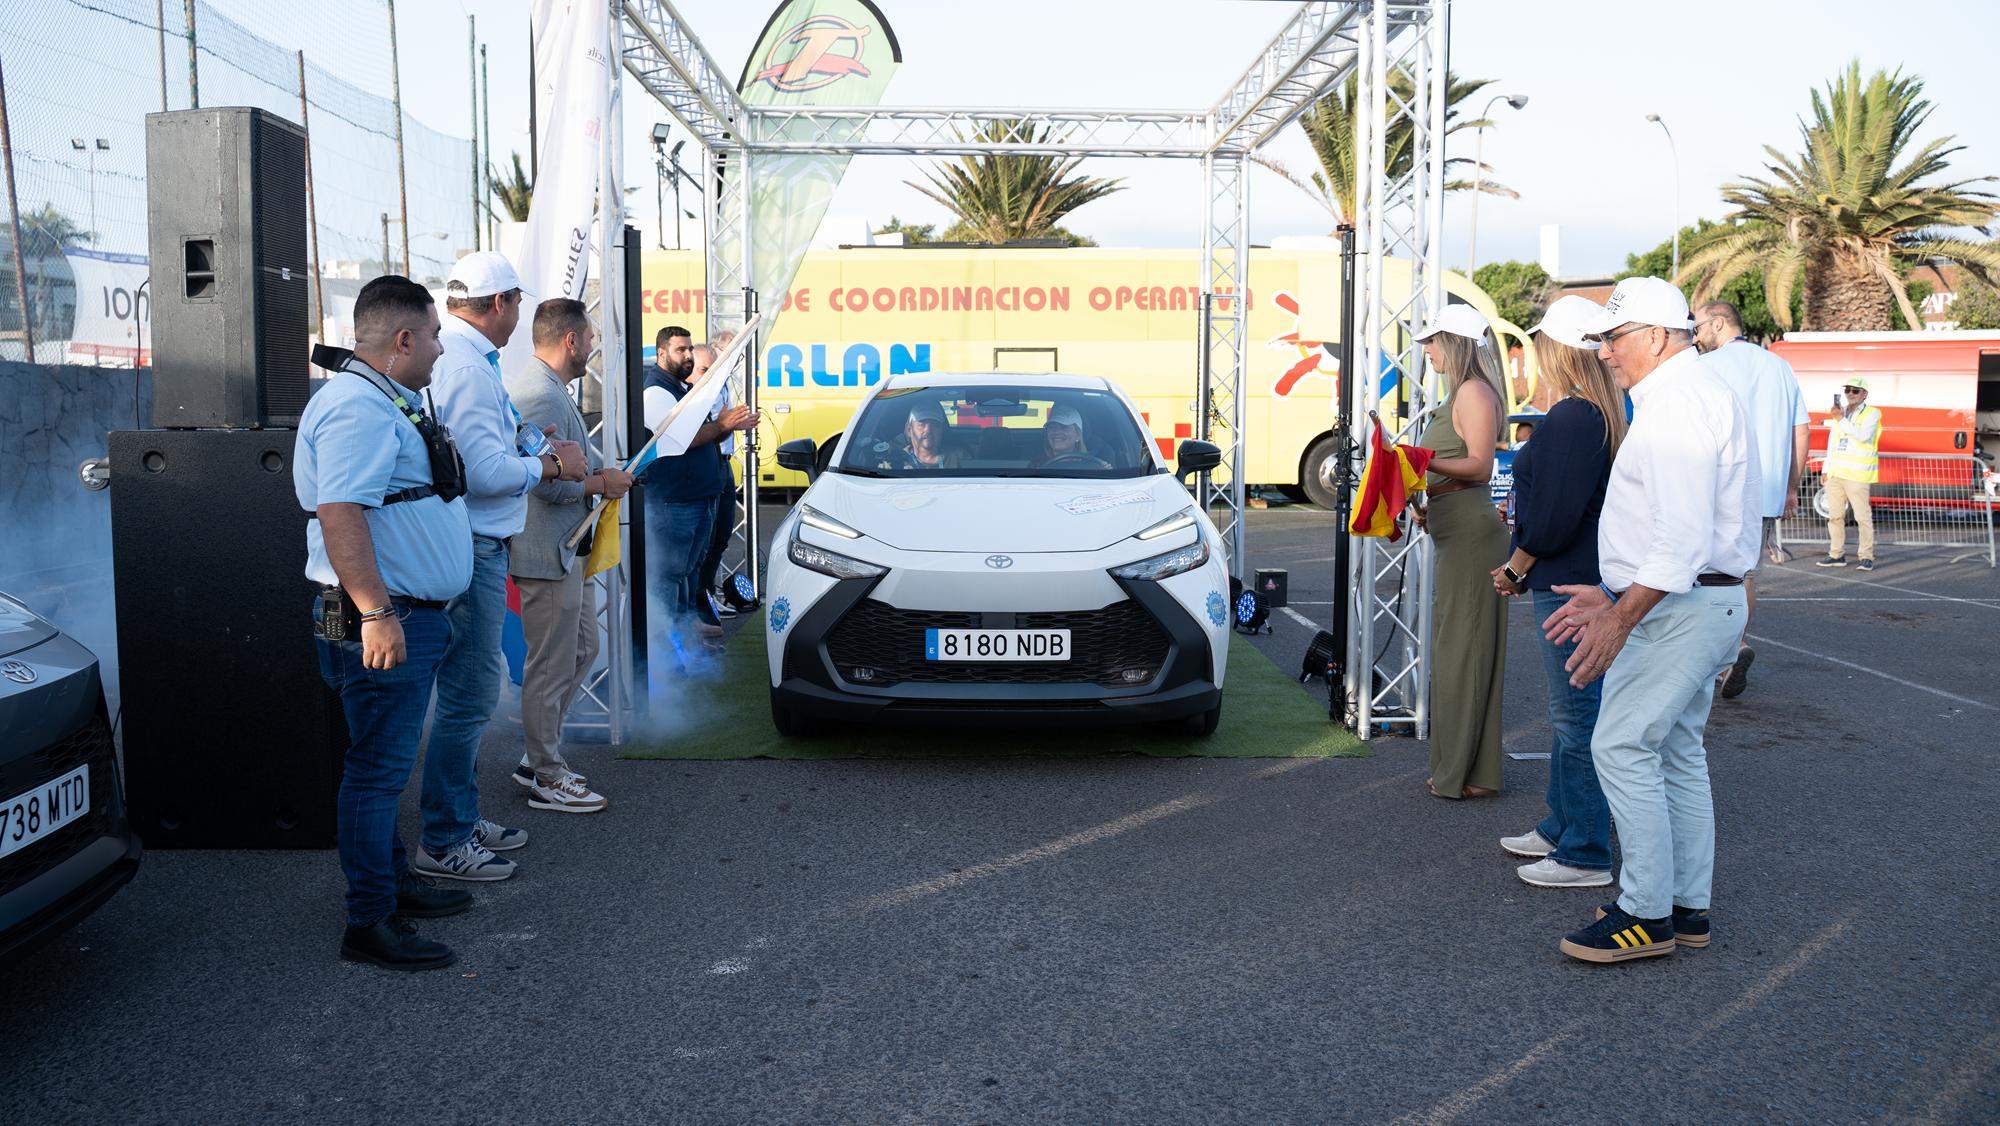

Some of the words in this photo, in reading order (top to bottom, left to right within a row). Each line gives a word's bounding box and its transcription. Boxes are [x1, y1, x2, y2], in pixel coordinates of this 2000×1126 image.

[642, 289, 706, 313] CENT
[829, 287, 1070, 312] COORDINACION
[1088, 286, 1254, 312] OPERATV
[944, 634, 1008, 656] 8180
[1017, 634, 1064, 656] NDB
[0, 796, 41, 847] 738
[48, 774, 85, 826] MTD
